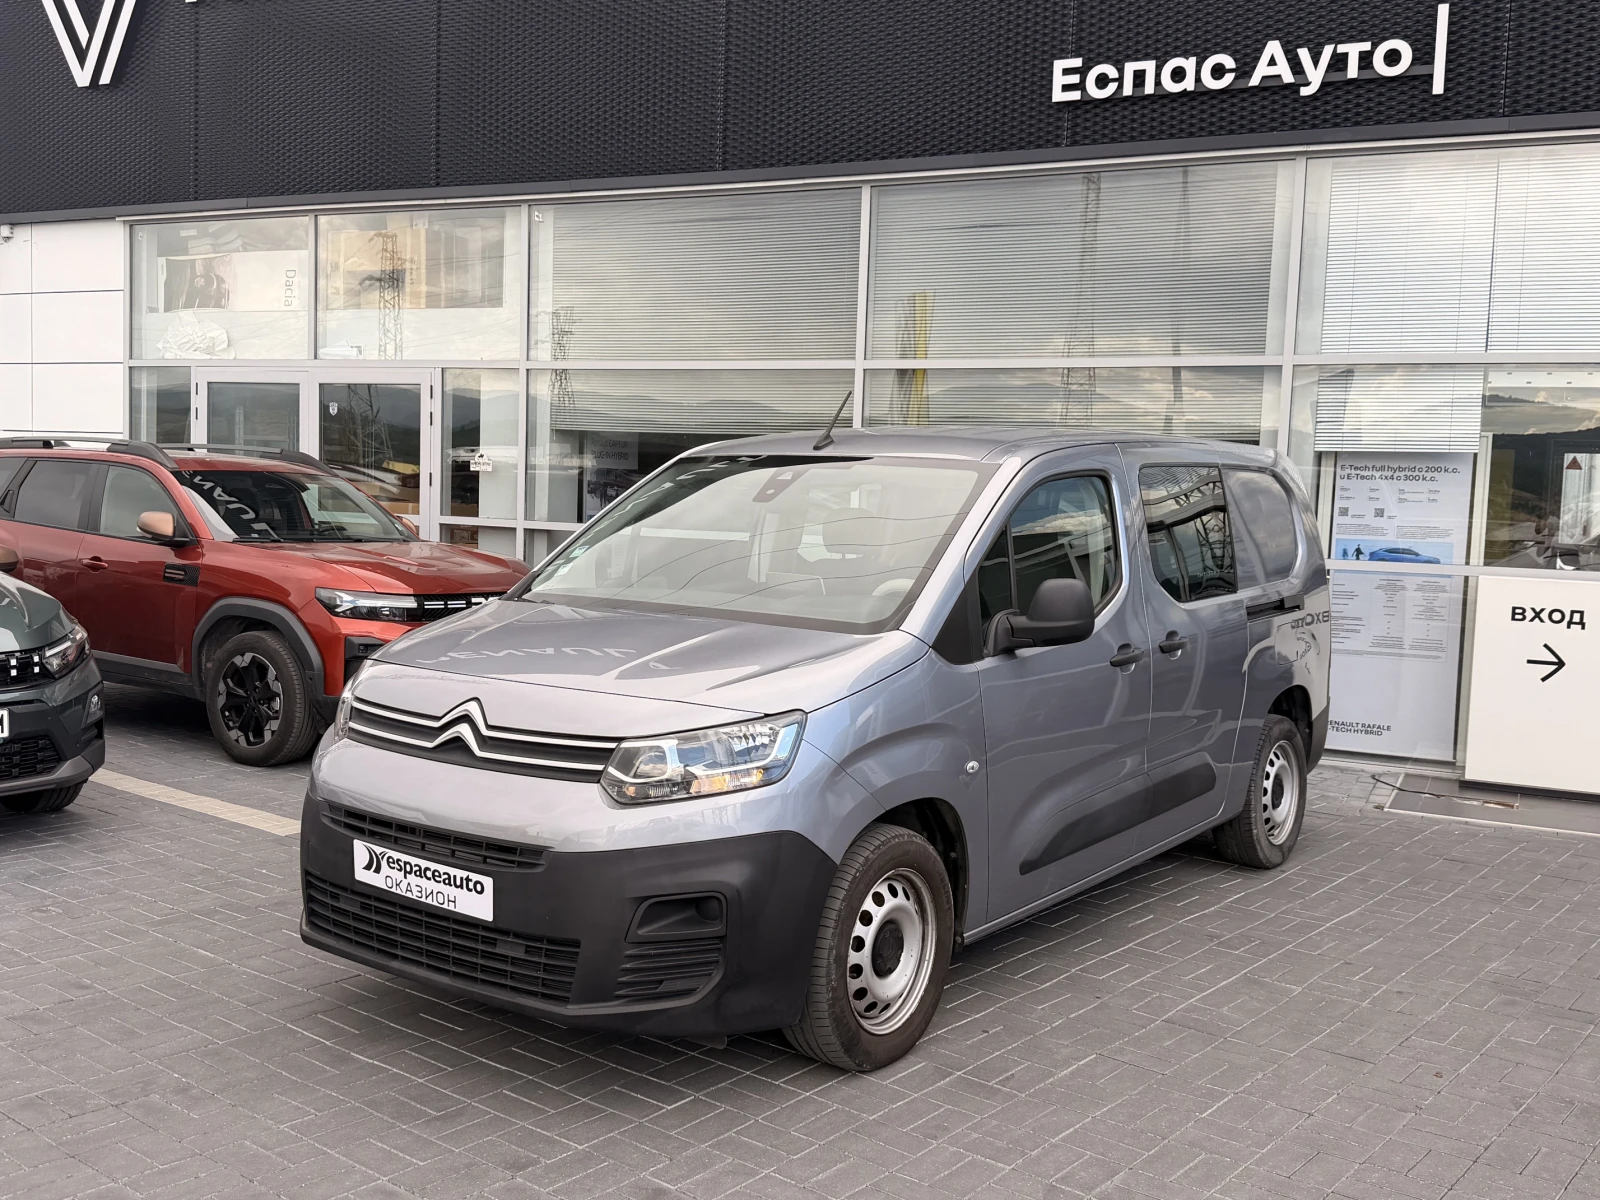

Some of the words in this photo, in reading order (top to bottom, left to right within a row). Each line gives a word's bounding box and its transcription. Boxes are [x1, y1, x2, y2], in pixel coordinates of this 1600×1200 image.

[1052, 53, 1237, 103] Еспас
[1248, 38, 1413, 97] Ауто
[284, 269, 297, 308] Dacia
[1340, 464, 1371, 472] E-Tech
[1371, 464, 1386, 473] full
[1387, 464, 1417, 474] hybrid
[1424, 465, 1443, 474] 200
[1346, 473, 1377, 481] E-Tech
[1378, 473, 1395, 481] 4x4
[1402, 474, 1421, 482] 300
[1328, 719, 1360, 728] ENAULT
[1360, 722, 1392, 732] RAFALE
[1328, 725, 1352, 734] -TECH
[1353, 728, 1383, 737] HYBRID
[386, 854, 485, 895] espaceauto
[384, 875, 458, 910] ОКАЗИОН
